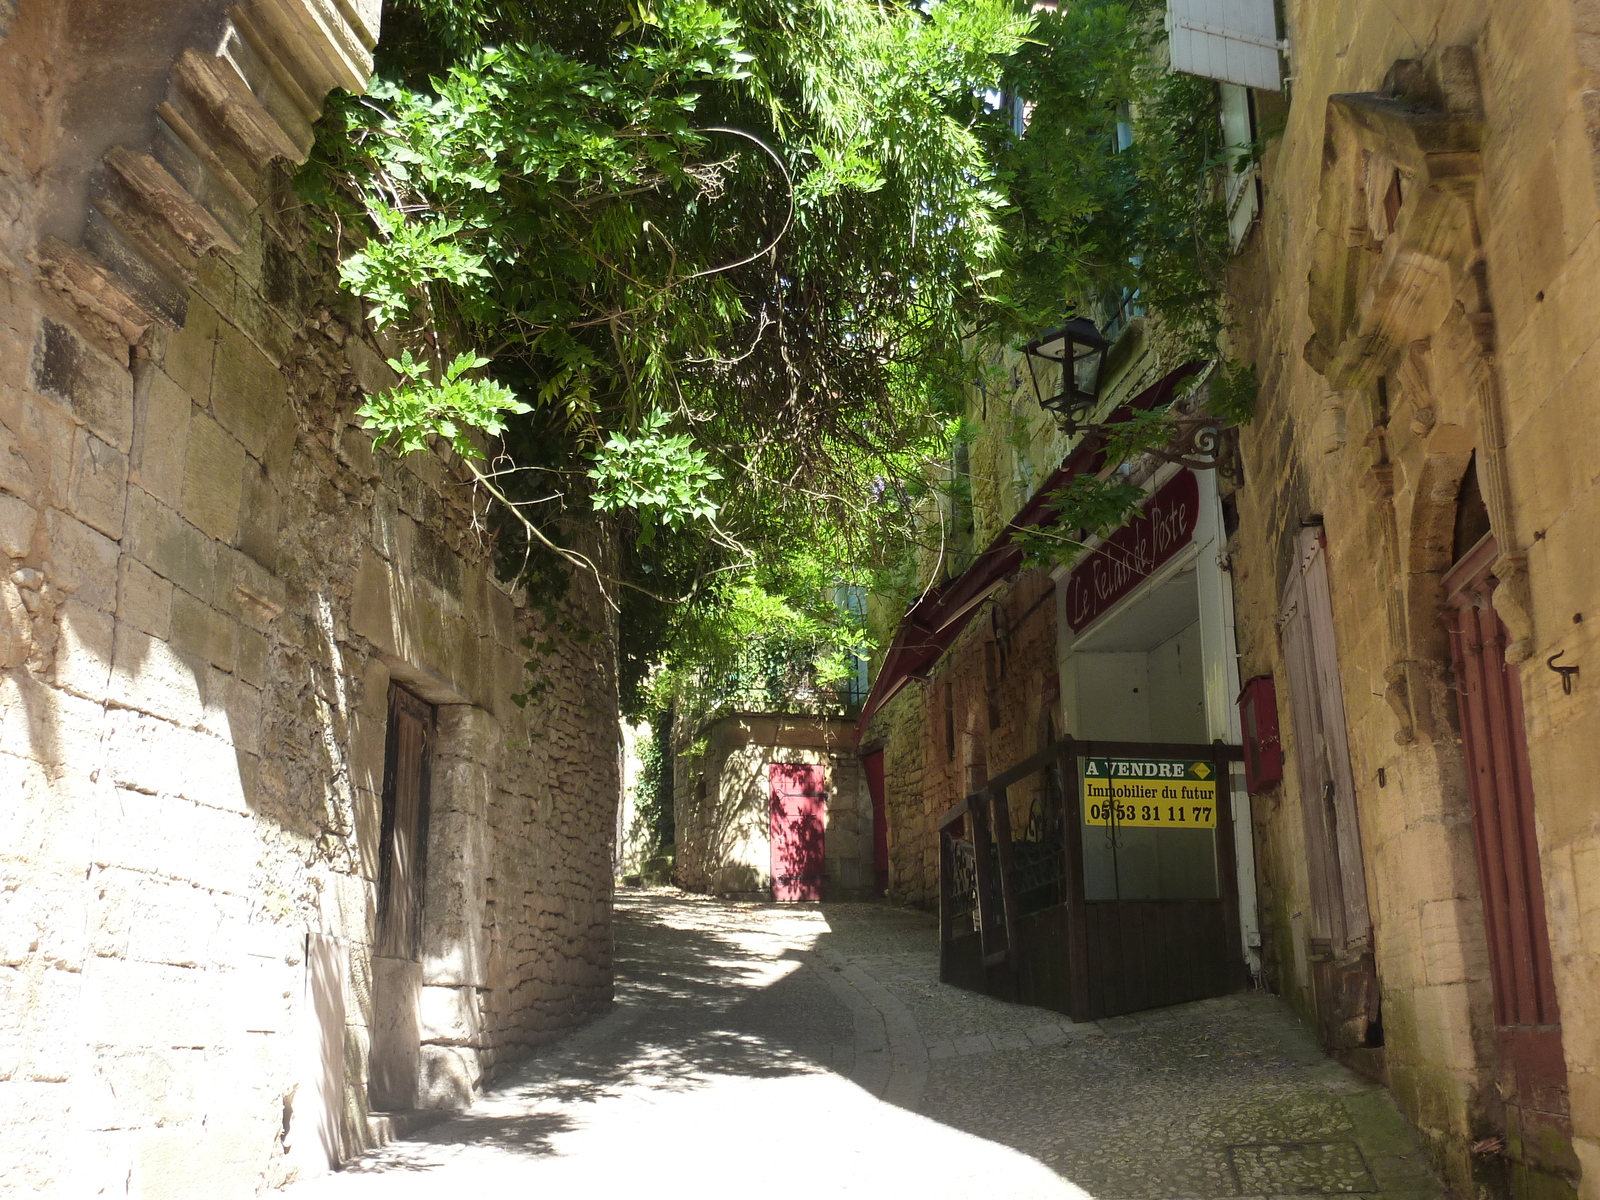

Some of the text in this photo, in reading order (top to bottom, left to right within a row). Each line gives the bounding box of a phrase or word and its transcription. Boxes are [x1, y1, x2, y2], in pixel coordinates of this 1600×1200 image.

[1073, 499, 1188, 625] Le Relais de Poste
[1086, 761, 1185, 778] A VENDRE
[1087, 783, 1214, 800] Immobilier du futur
[1090, 804, 1212, 822] 05 53 31 11 77
